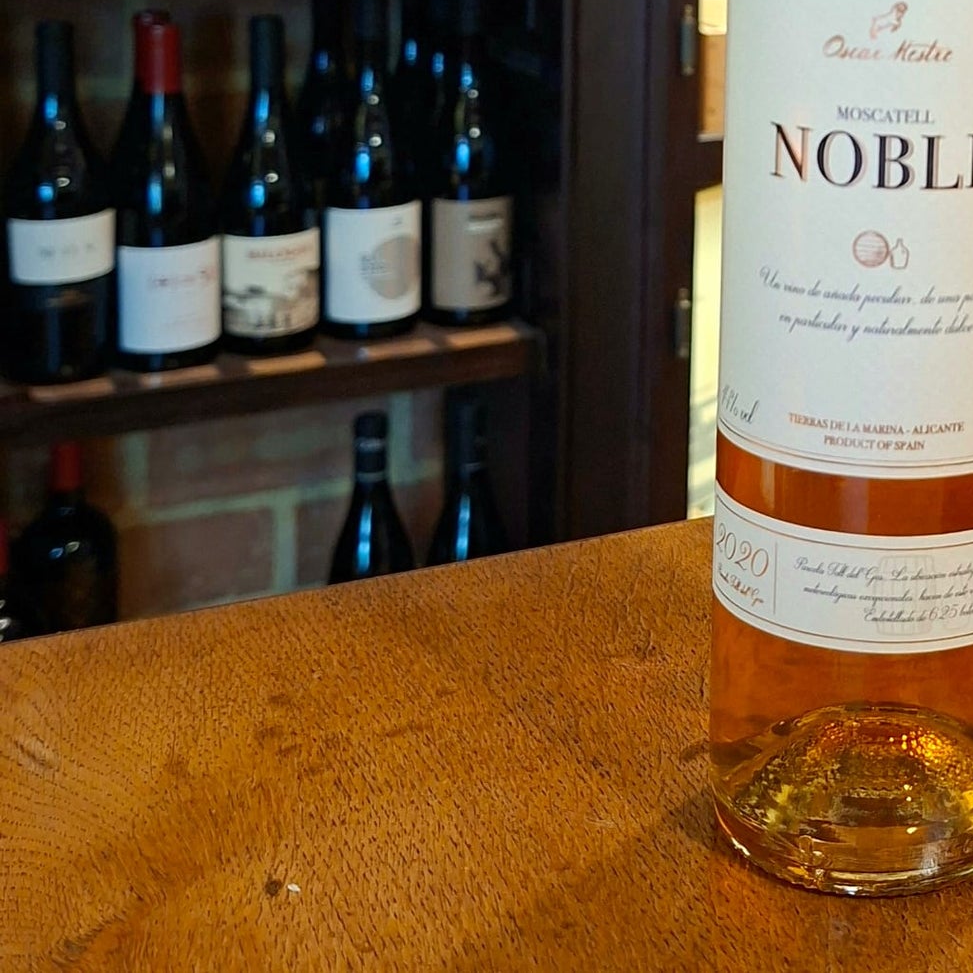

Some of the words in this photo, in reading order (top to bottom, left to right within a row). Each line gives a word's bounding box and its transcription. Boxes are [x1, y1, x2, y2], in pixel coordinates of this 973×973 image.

[893, 38, 953, 62] Mestre
[836, 105, 935, 124] MOSCATELL
[760, 265, 780, 289] Un
[783, 283, 806, 295] vino
[807, 279, 822, 297] de
[920, 285, 937, 304] de
[937, 294, 961, 305] una
[779, 314, 793, 324] en
[788, 310, 849, 333] particular
[847, 325, 861, 343] y
[863, 316, 943, 336] naturalmente
[829, 420, 846, 431] DE
[846, 422, 860, 433] LA
[862, 423, 905, 435] MARINA
[911, 421, 966, 436] ALICANTE
[824, 434, 876, 450] PRODUCT
[876, 439, 893, 451] OF
[894, 439, 926, 452] SPAIN
[716, 522, 770, 578] 2020
[928, 604, 958, 621] 625
